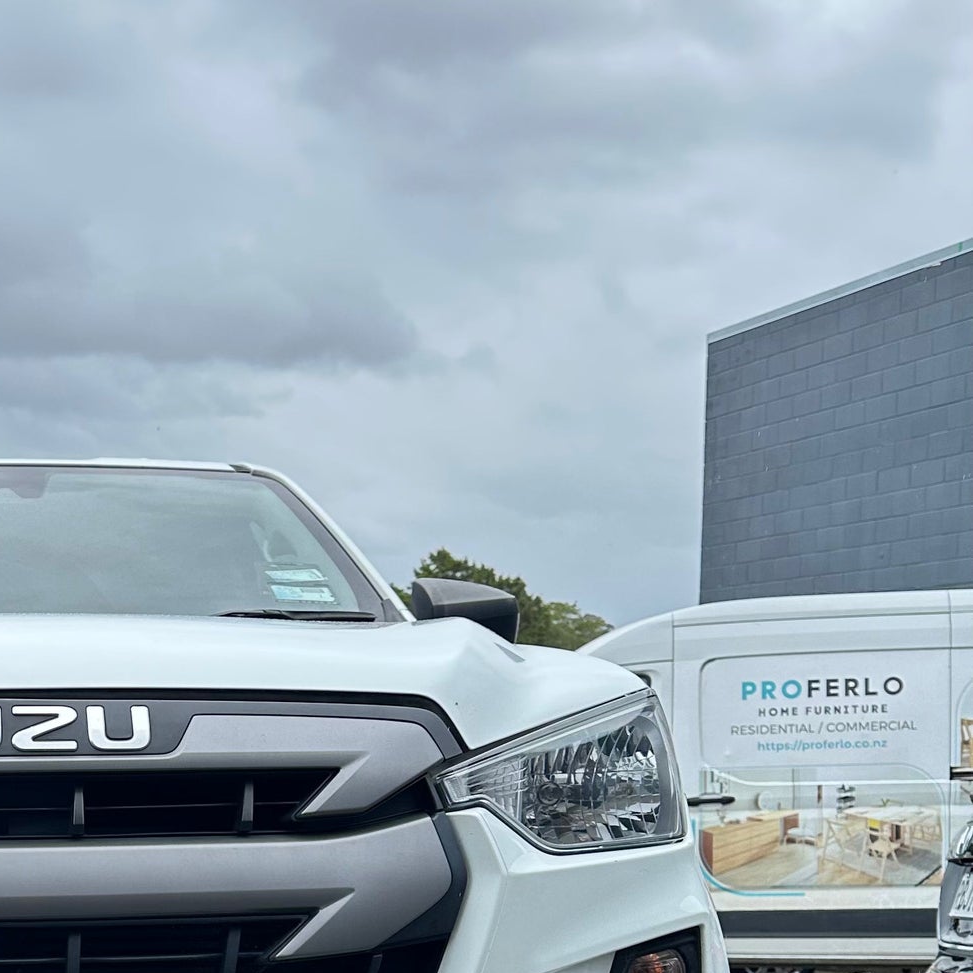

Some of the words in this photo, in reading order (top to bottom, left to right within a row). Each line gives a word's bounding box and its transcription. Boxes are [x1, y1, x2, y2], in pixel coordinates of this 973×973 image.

[741, 676, 904, 700] PROFERLO
[758, 707, 799, 717] HOME
[805, 703, 888, 715] FURNITURE
[730, 724, 814, 736] RESIDENTIAL
[826, 720, 917, 734] COMMERCIAL
[757, 738, 887, 752] https://proferlo.co.nz
